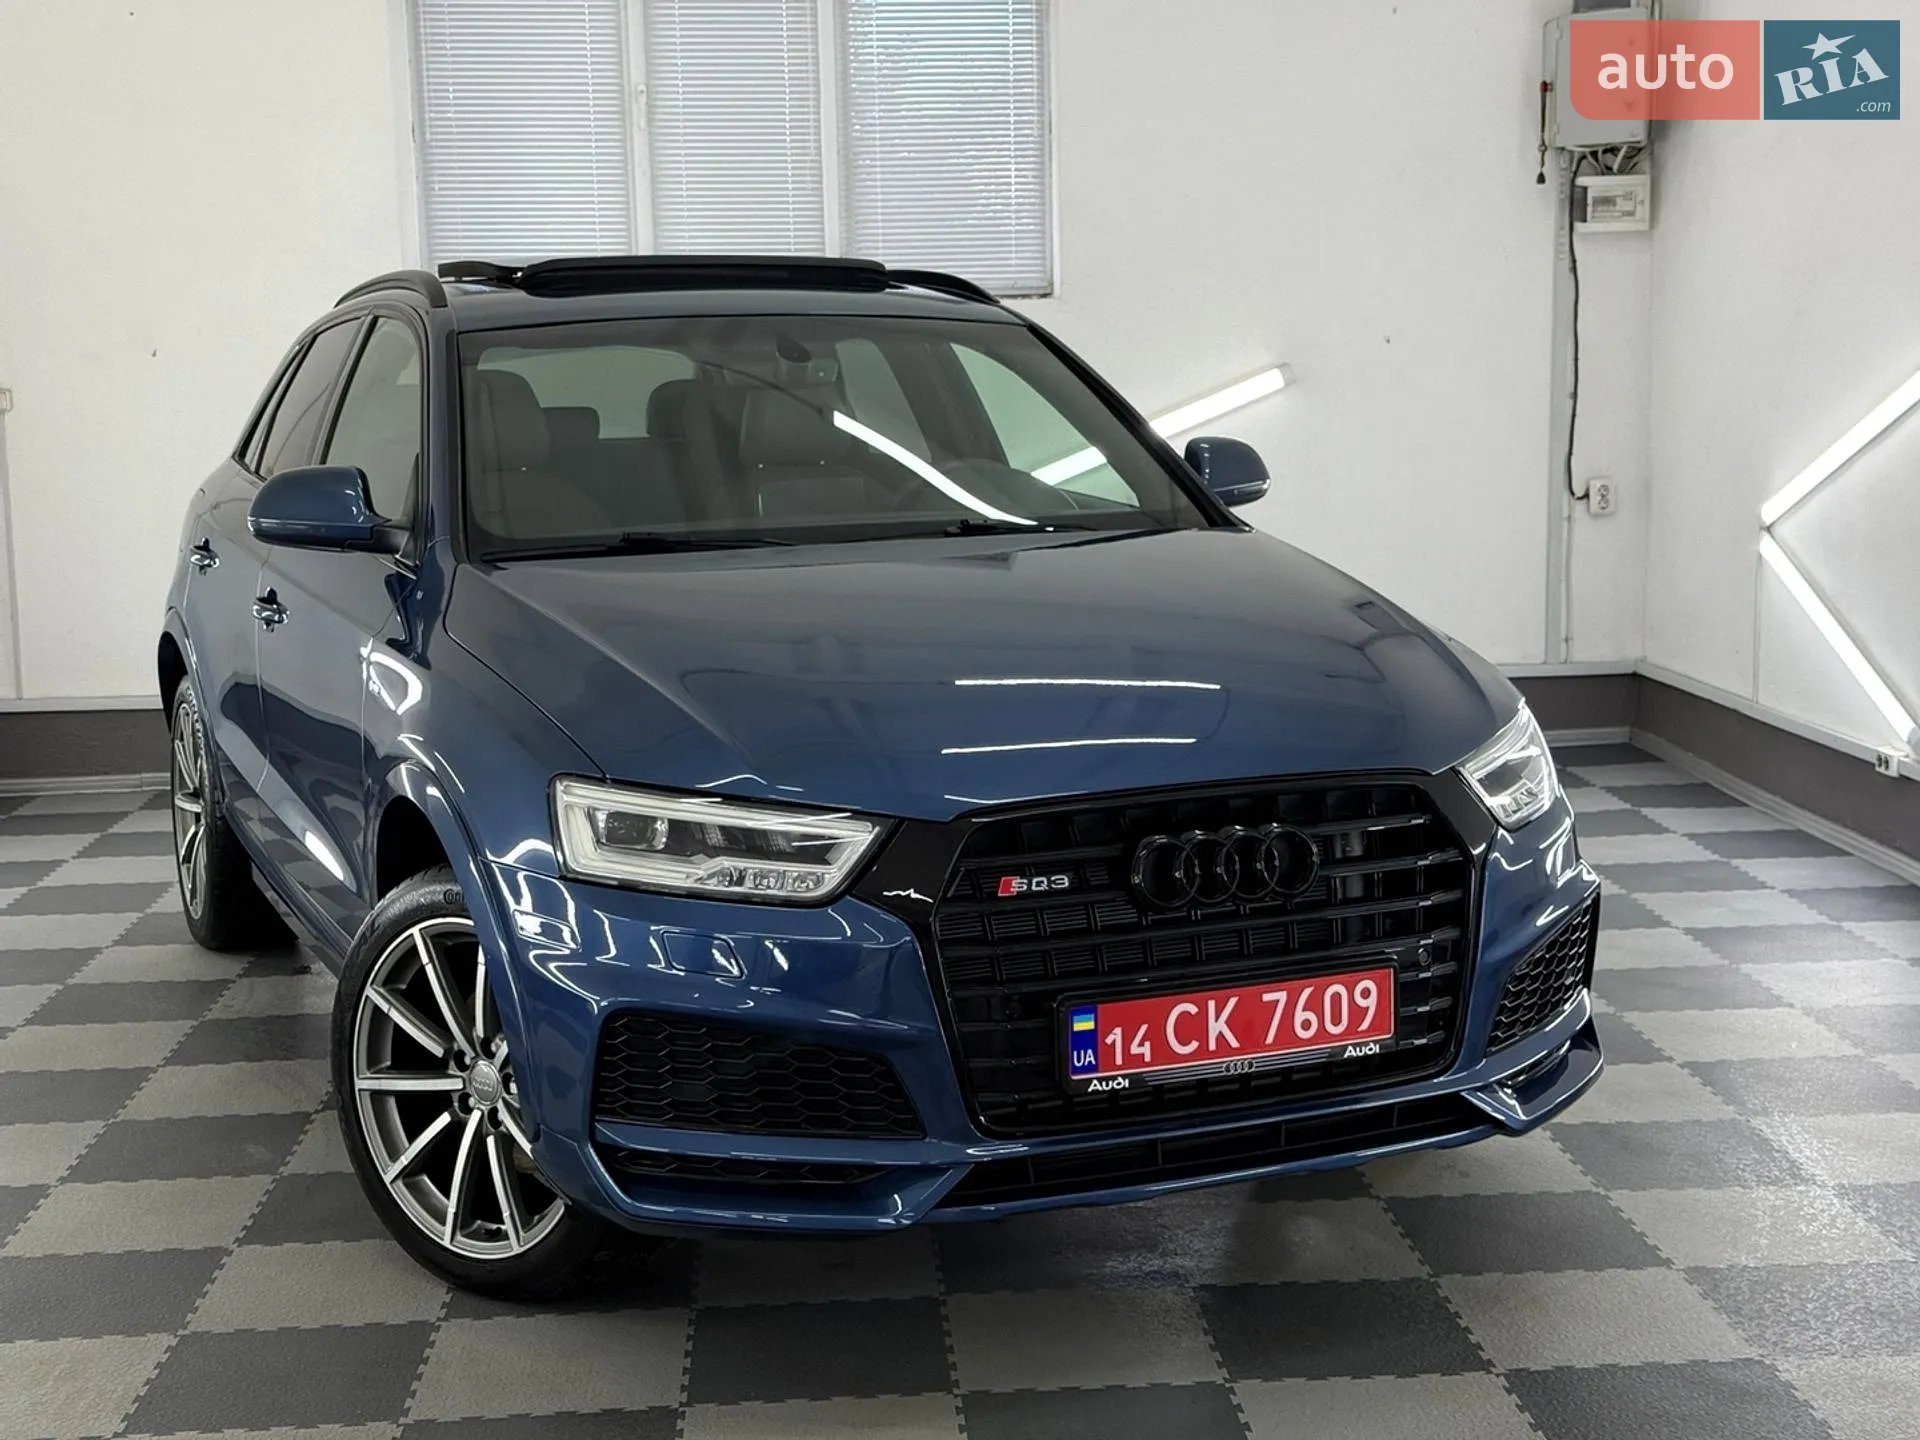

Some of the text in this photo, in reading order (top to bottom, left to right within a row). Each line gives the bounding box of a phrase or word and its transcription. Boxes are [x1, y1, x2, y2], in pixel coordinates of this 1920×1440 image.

[1010, 875, 1069, 892] SQ3
[1104, 979, 1378, 1066] 14 CK 7609
[1073, 1049, 1096, 1067] UA
[1344, 1042, 1380, 1058] Audi
[1087, 1077, 1130, 1093] Audi
